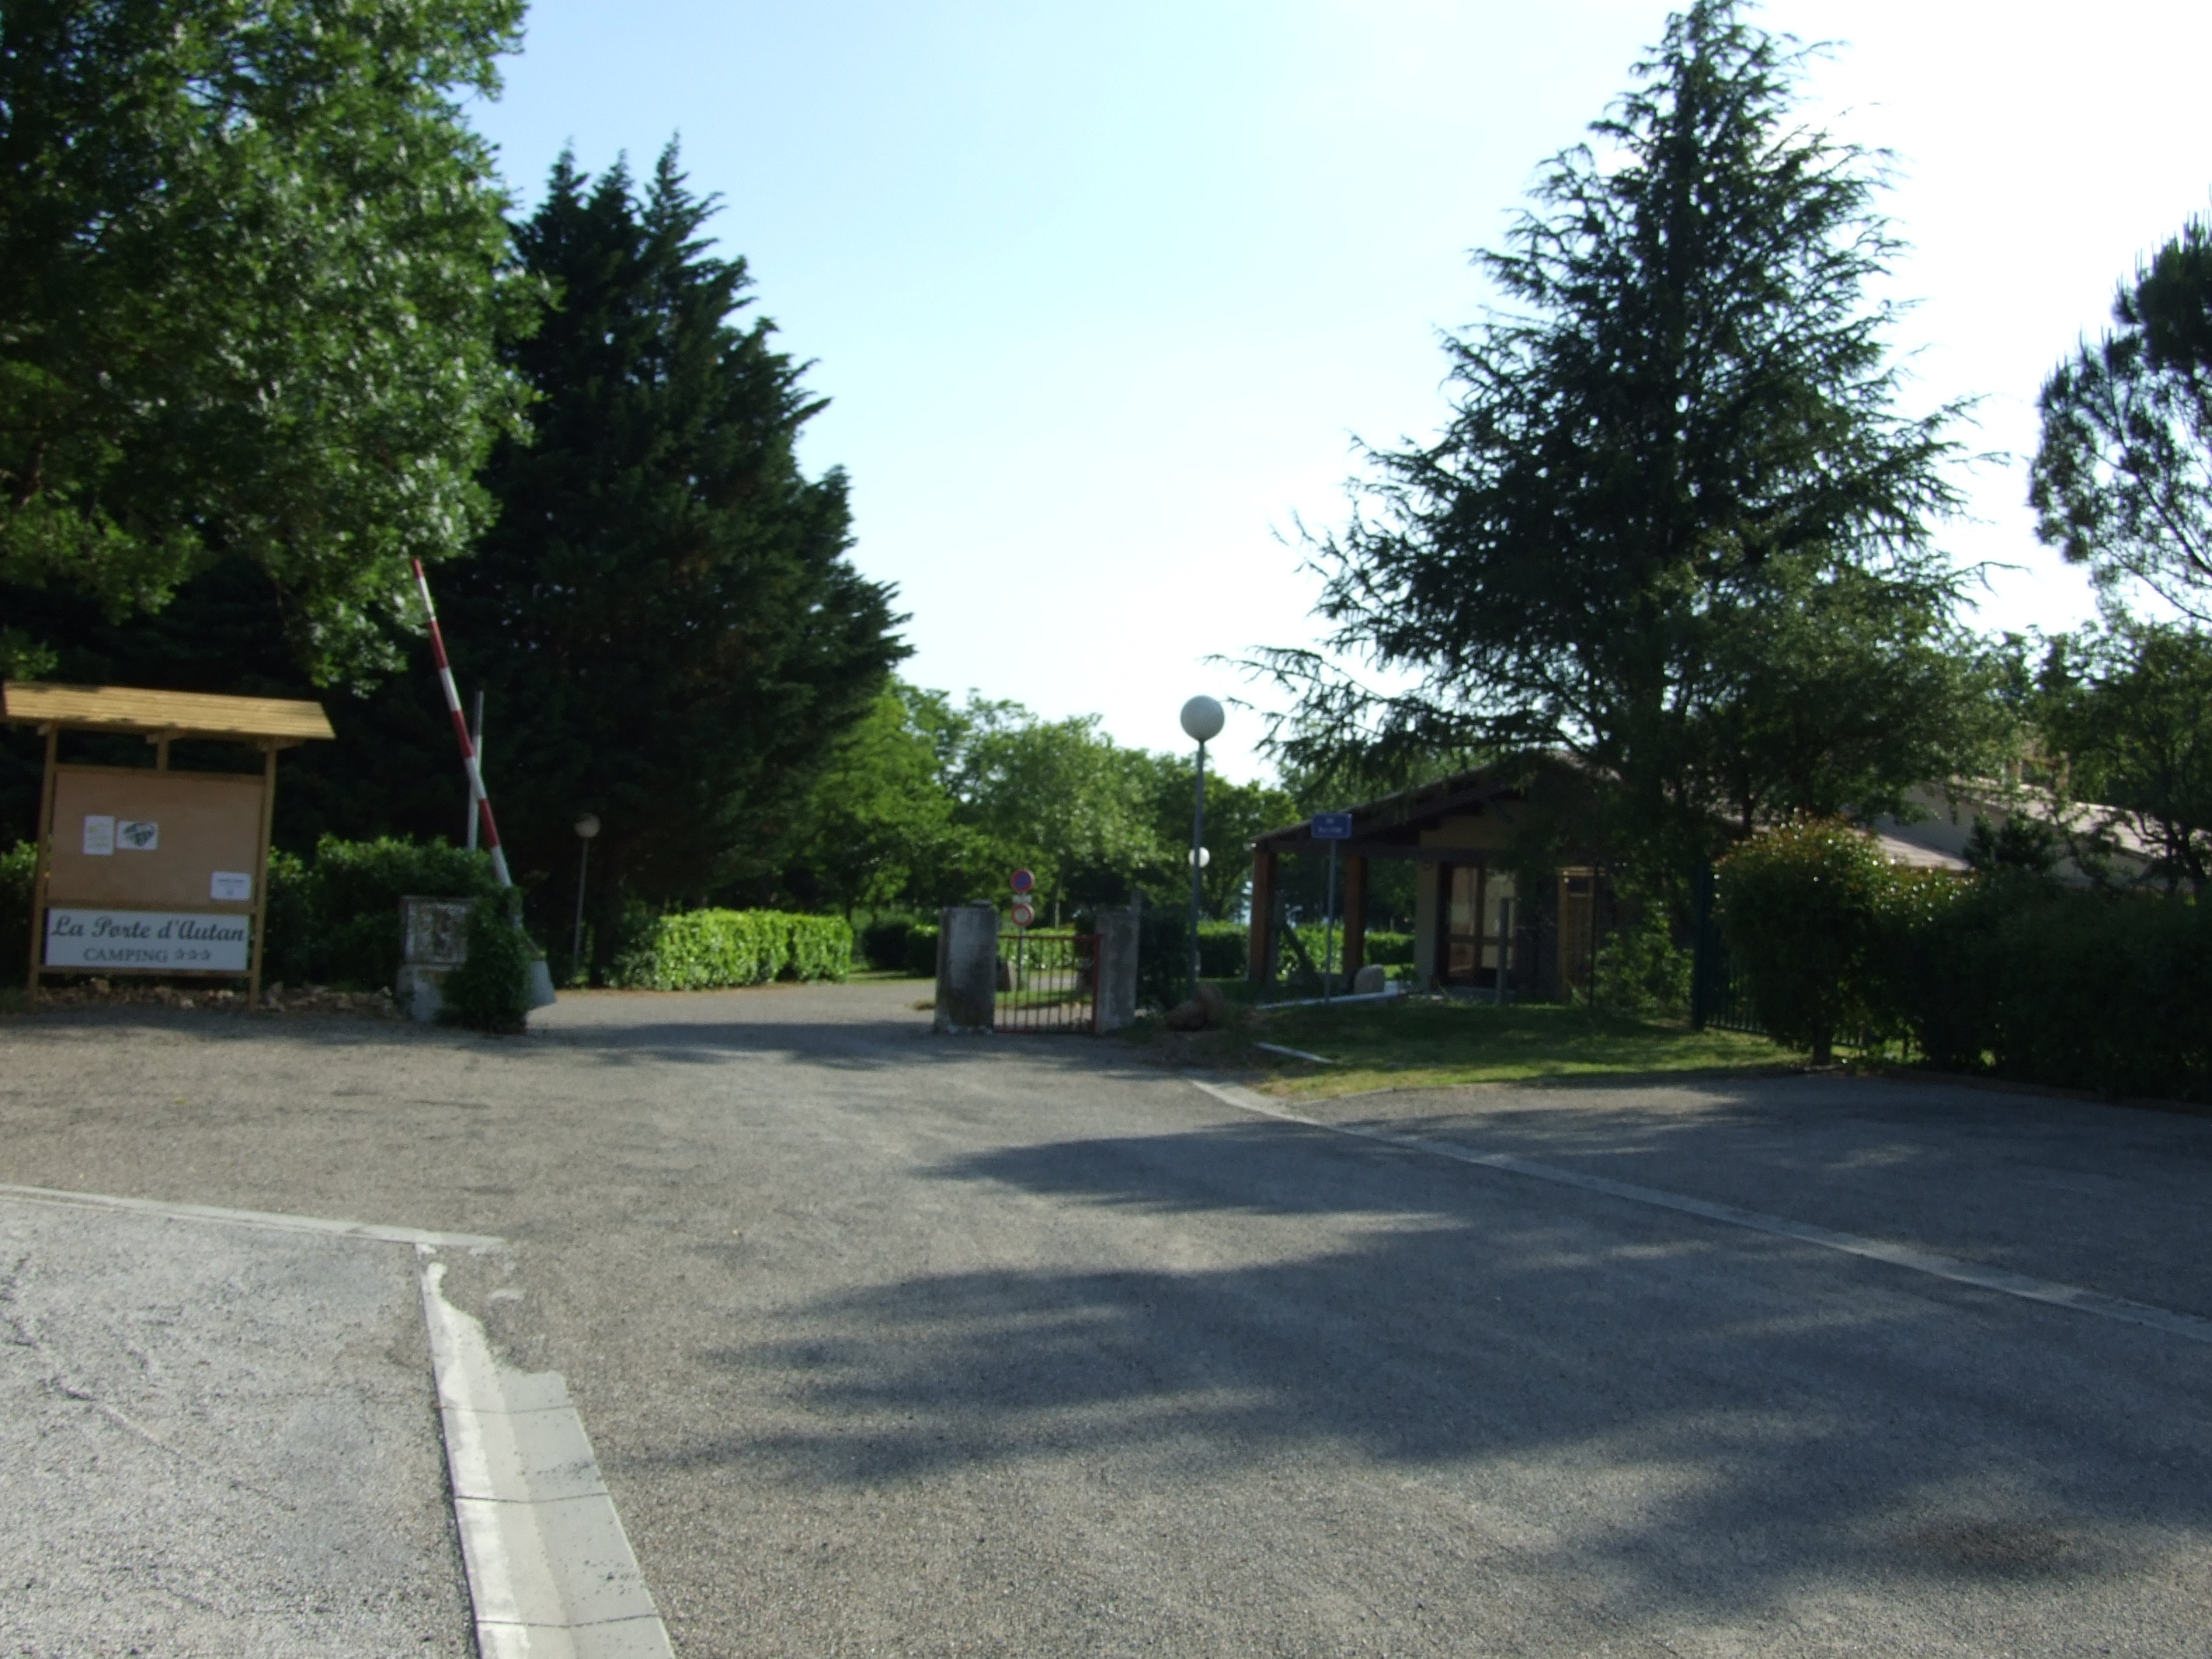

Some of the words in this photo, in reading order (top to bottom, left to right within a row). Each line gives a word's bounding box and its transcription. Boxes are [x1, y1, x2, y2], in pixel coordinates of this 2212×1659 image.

[50, 915, 84, 937] La
[91, 915, 151, 939] Porte
[157, 919, 244, 941] d'Autan
[82, 946, 169, 962] CAMPING
